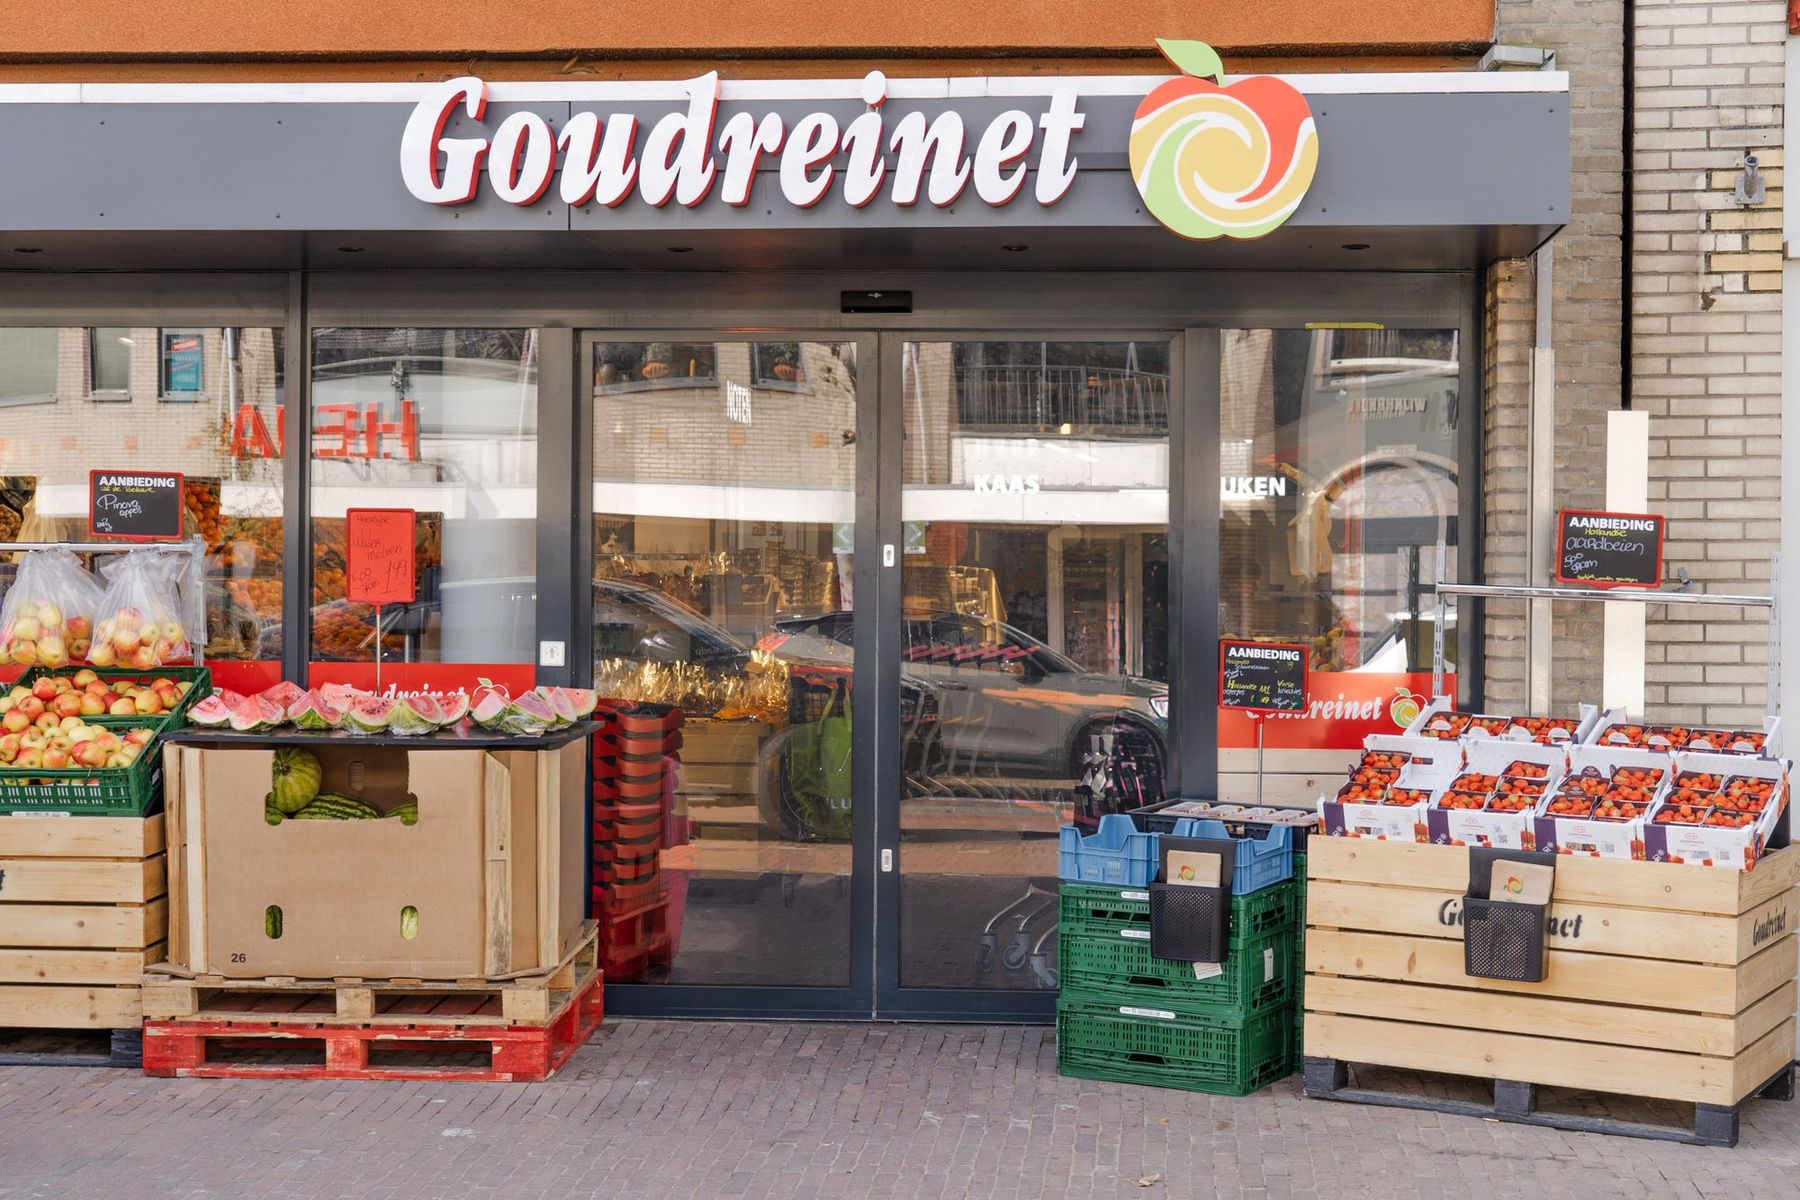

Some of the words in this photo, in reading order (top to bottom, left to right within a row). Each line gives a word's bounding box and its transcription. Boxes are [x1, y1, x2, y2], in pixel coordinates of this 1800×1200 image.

[400, 69, 1086, 208] Goudreinet
[98, 475, 176, 488] AANBIEDING
[973, 473, 1040, 495] KAAS
[1220, 476, 1286, 497] UKEN
[1569, 516, 1655, 531] AANBIEDING
[1228, 646, 1300, 661] AANBIEDING
[1246, 692, 1383, 721] reinet
[231, 953, 246, 963] 26
